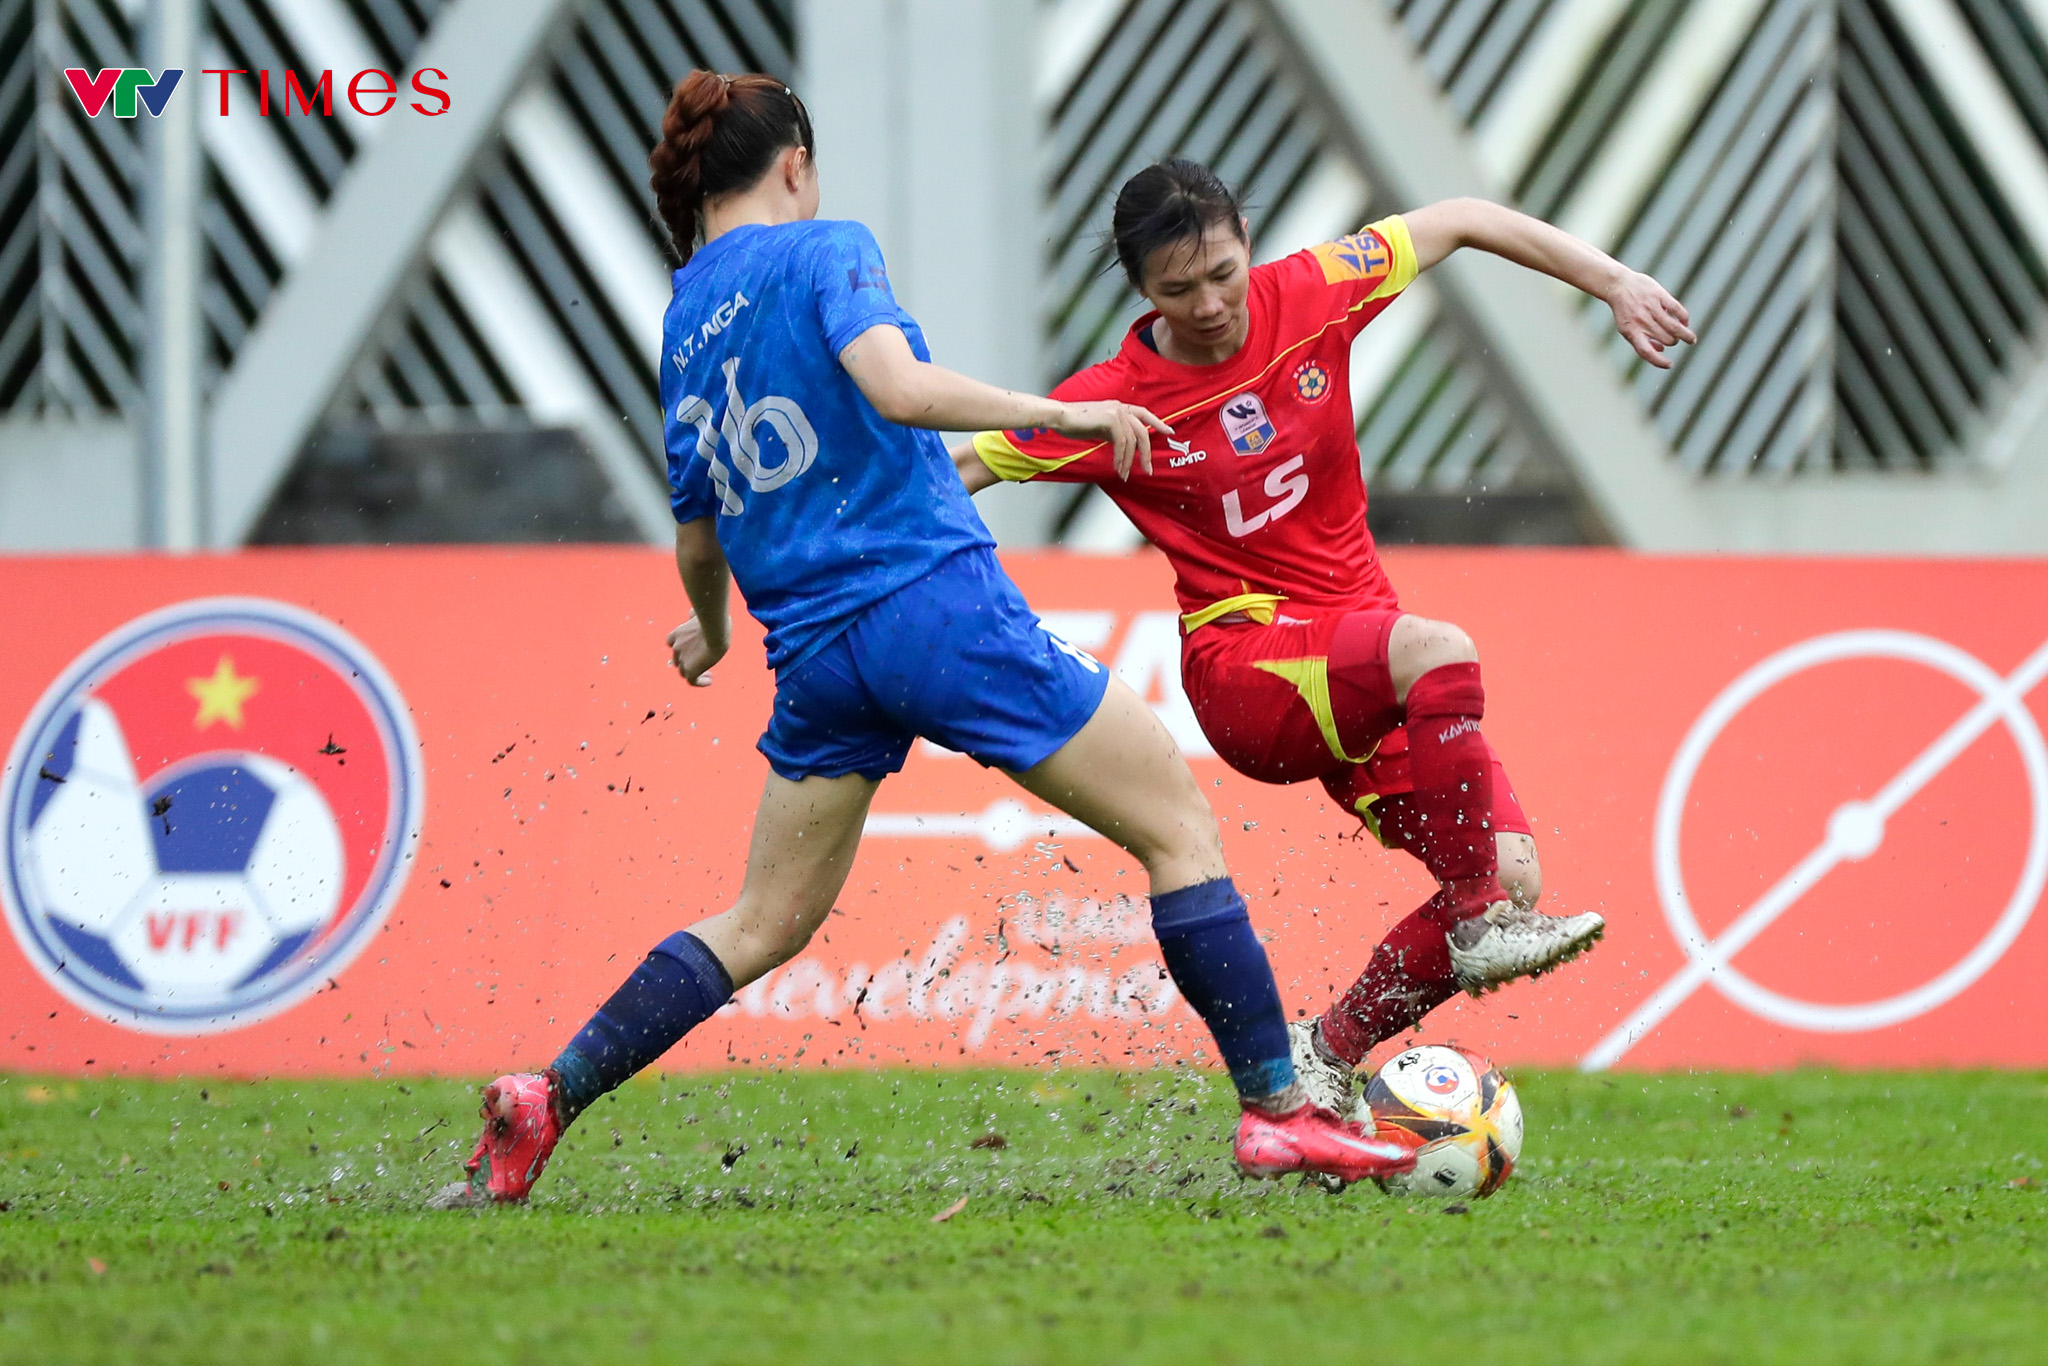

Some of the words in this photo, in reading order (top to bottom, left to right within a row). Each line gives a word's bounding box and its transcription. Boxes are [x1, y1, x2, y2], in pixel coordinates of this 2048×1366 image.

[676, 356, 818, 516] 16
[1169, 450, 1207, 469] KAMITO
[1222, 453, 1310, 538] LS
[145, 909, 246, 953] VFF
